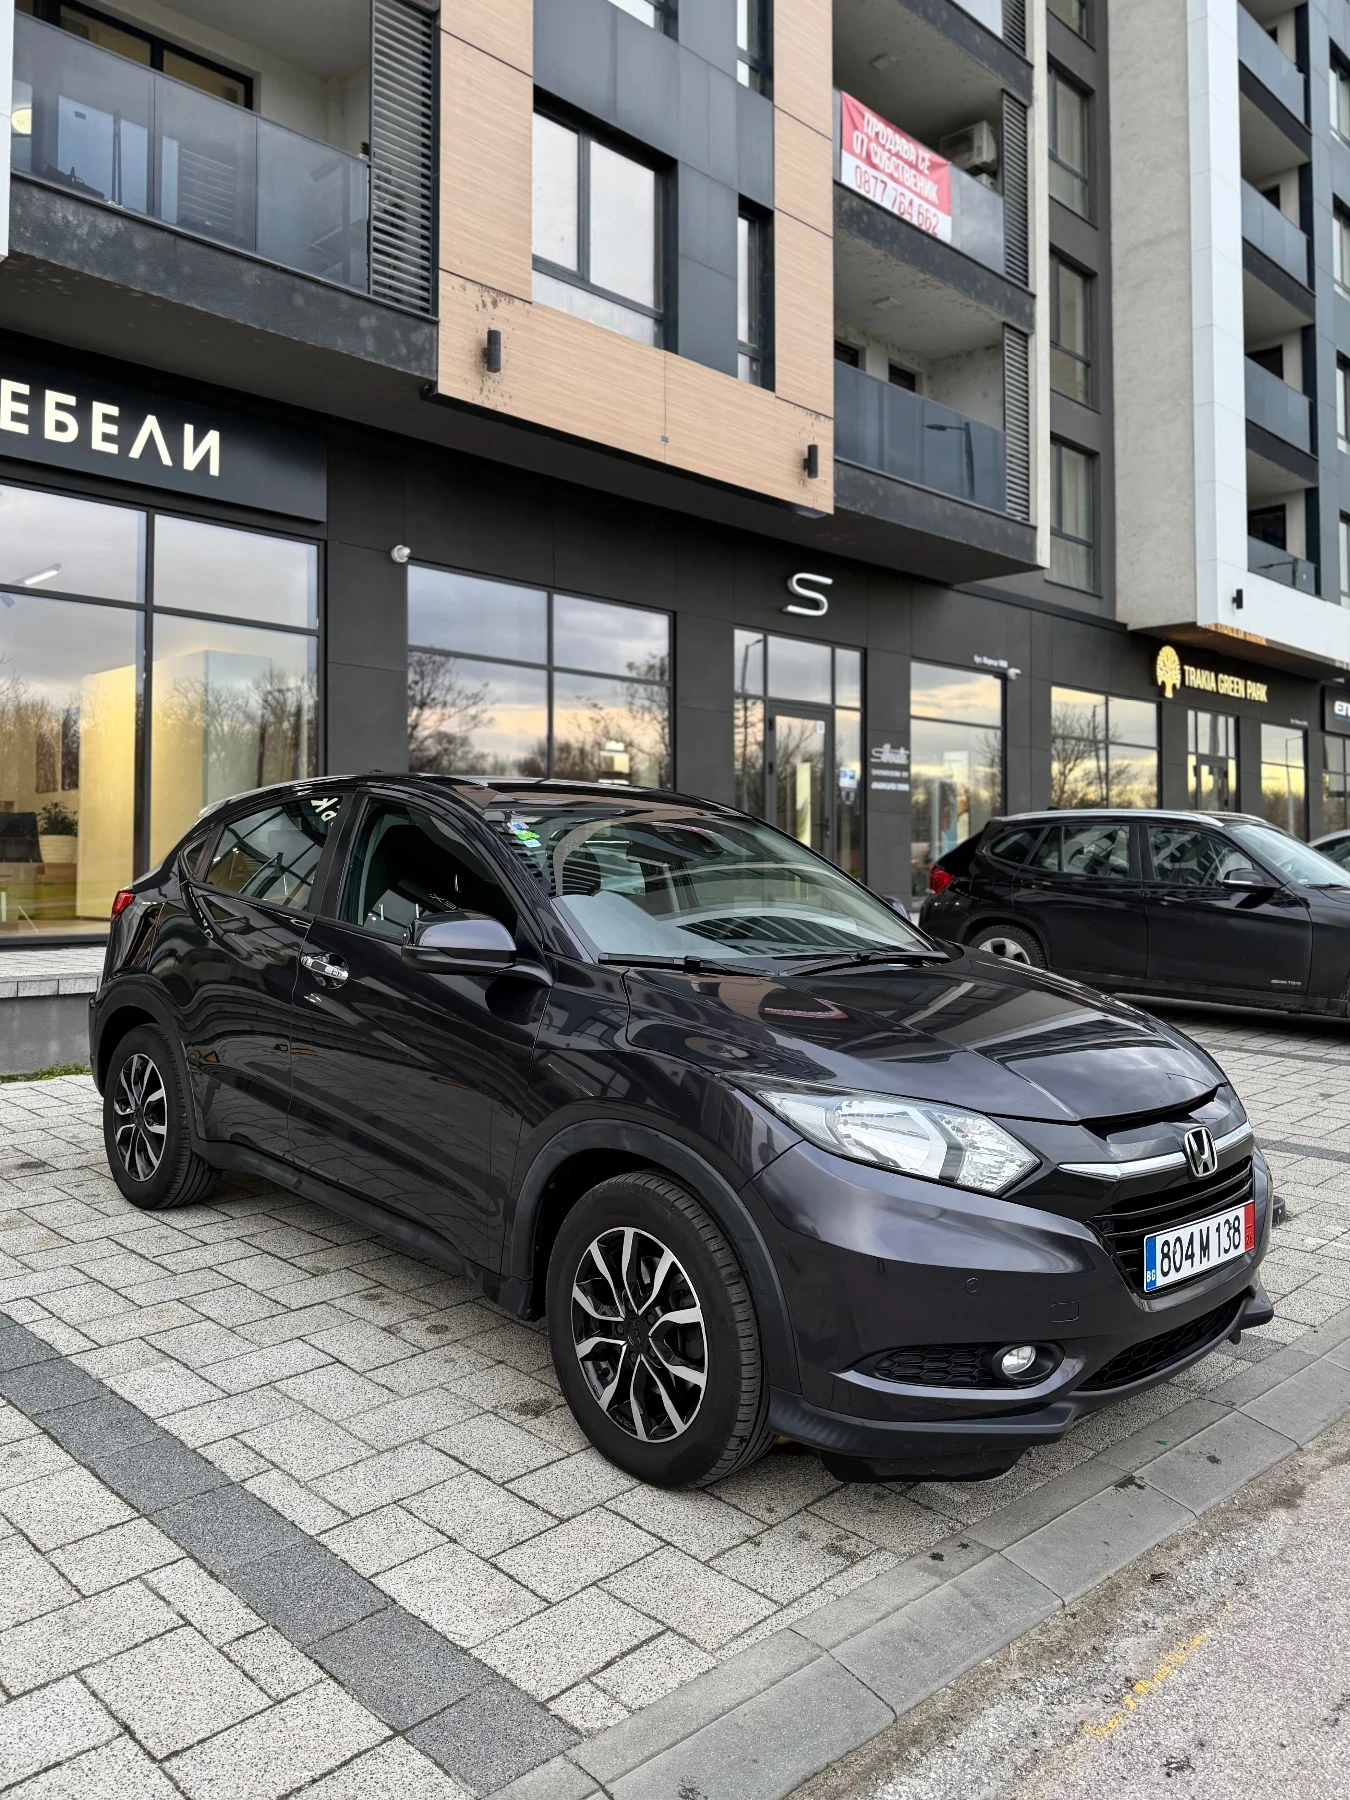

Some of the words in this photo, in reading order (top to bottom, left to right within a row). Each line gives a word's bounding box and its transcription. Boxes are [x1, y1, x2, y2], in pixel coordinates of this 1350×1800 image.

[863, 111, 917, 166] ПРОДАВА
[917, 148, 932, 175] СЕ
[869, 142, 940, 206] СОБСТВЕНИК
[854, 164, 888, 203] 0877
[891, 186, 914, 222] 764
[916, 203, 940, 237] 662
[786, 572, 834, 617] S
[1183, 665, 1217, 692] TRAKIA
[1218, 673, 1245, 698] GREEN
[1246, 680, 1268, 702] PARK
[1147, 1269, 1156, 1283] BG
[1160, 1231, 1196, 1278] 804
[1200, 1226, 1210, 1264] M
[1214, 1214, 1241, 1258] 138
